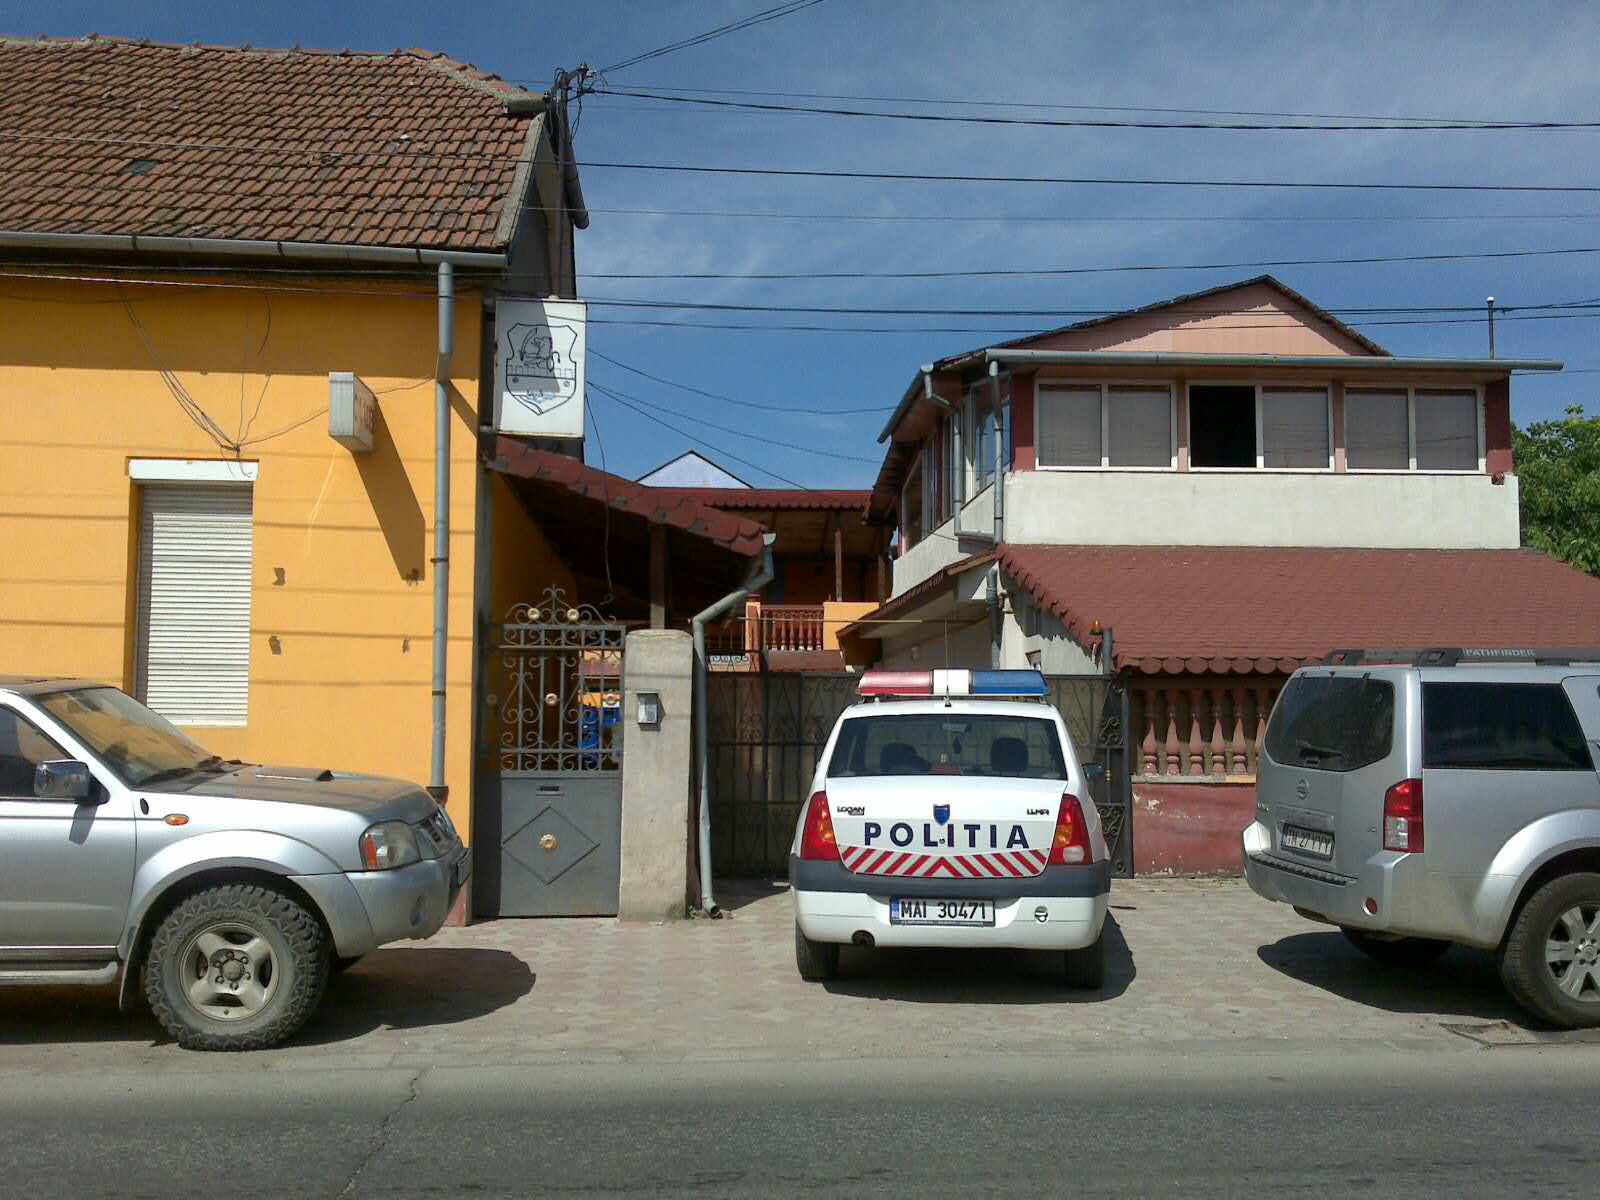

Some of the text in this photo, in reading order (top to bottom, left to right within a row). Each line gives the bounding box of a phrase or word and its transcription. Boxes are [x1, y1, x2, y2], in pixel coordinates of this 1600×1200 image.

[1462, 648, 1537, 657] PATHFINDER
[864, 822, 1030, 849] POLITIA
[901, 901, 927, 918] MAI
[937, 902, 986, 919] 30471
